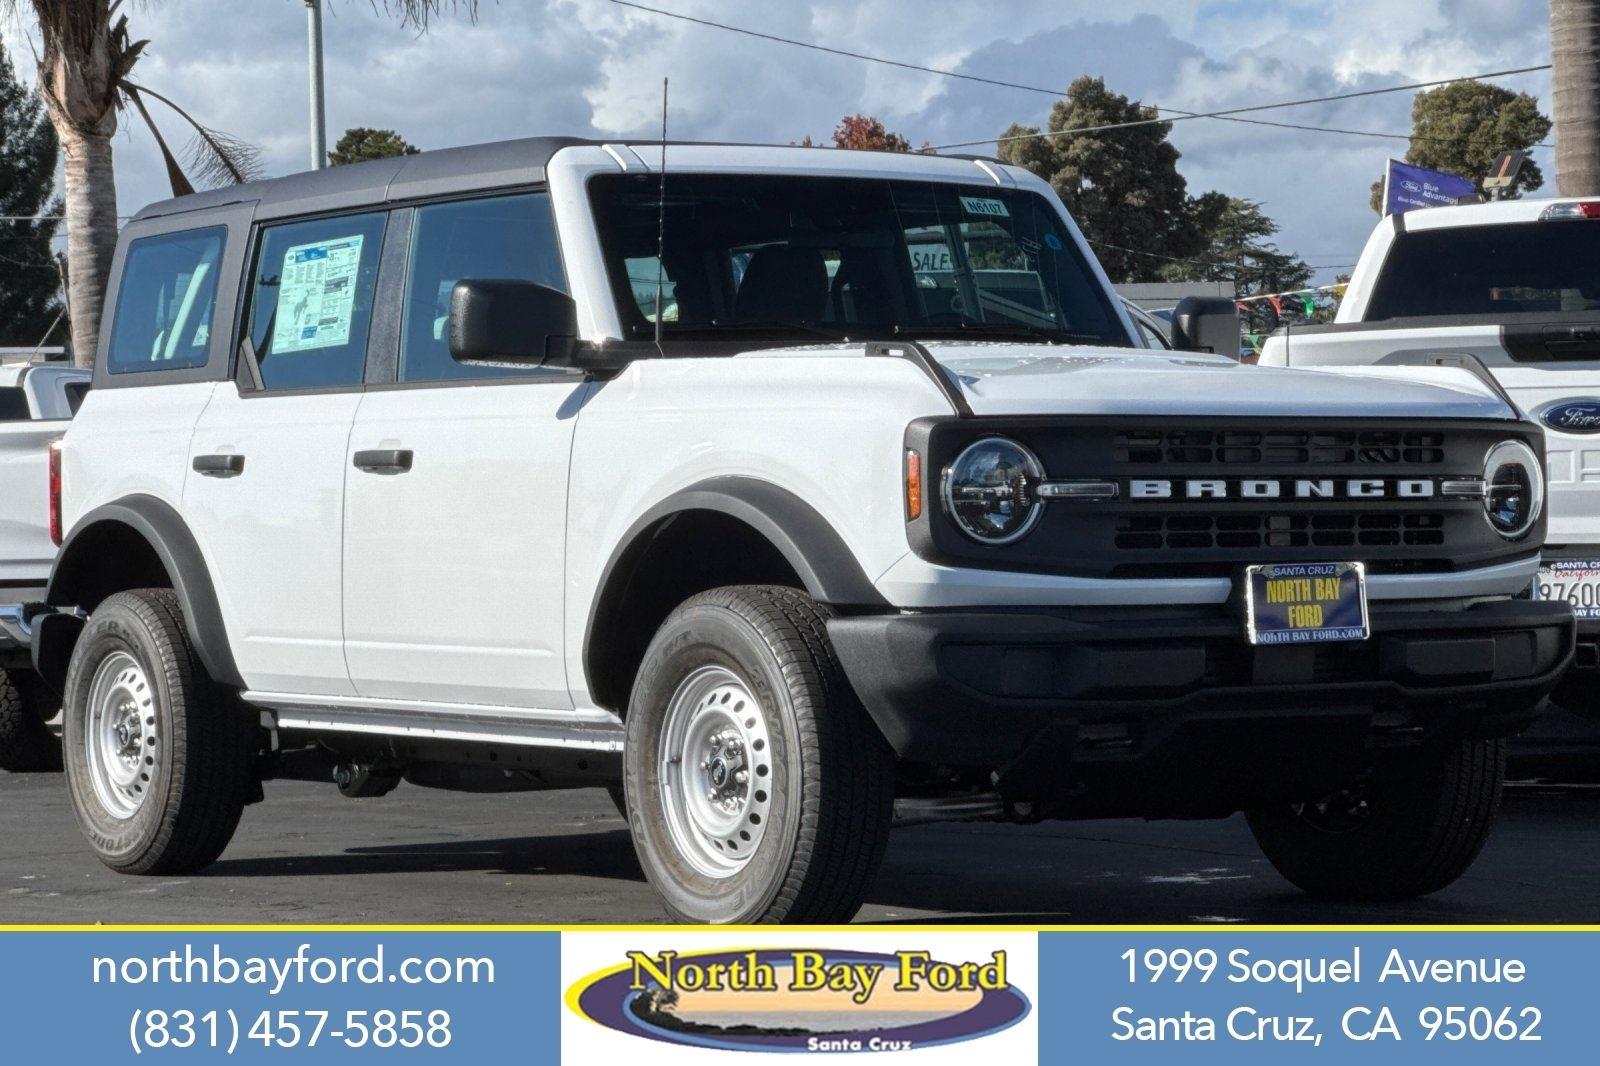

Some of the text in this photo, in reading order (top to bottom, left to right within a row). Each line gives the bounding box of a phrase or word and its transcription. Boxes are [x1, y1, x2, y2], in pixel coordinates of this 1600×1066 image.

[1423, 183, 1439, 192] Blue
[967, 201, 1001, 215] N6107
[1130, 480, 1434, 498] BRONCO
[1274, 565, 1335, 577] SANTA CRUZ
[1556, 561, 1587, 569] SANTA
[1266, 577, 1341, 603] NORTH BAY
[1287, 604, 1323, 628] FORD
[1257, 632, 1290, 643] NORTH
[1293, 631, 1310, 641] BAY
